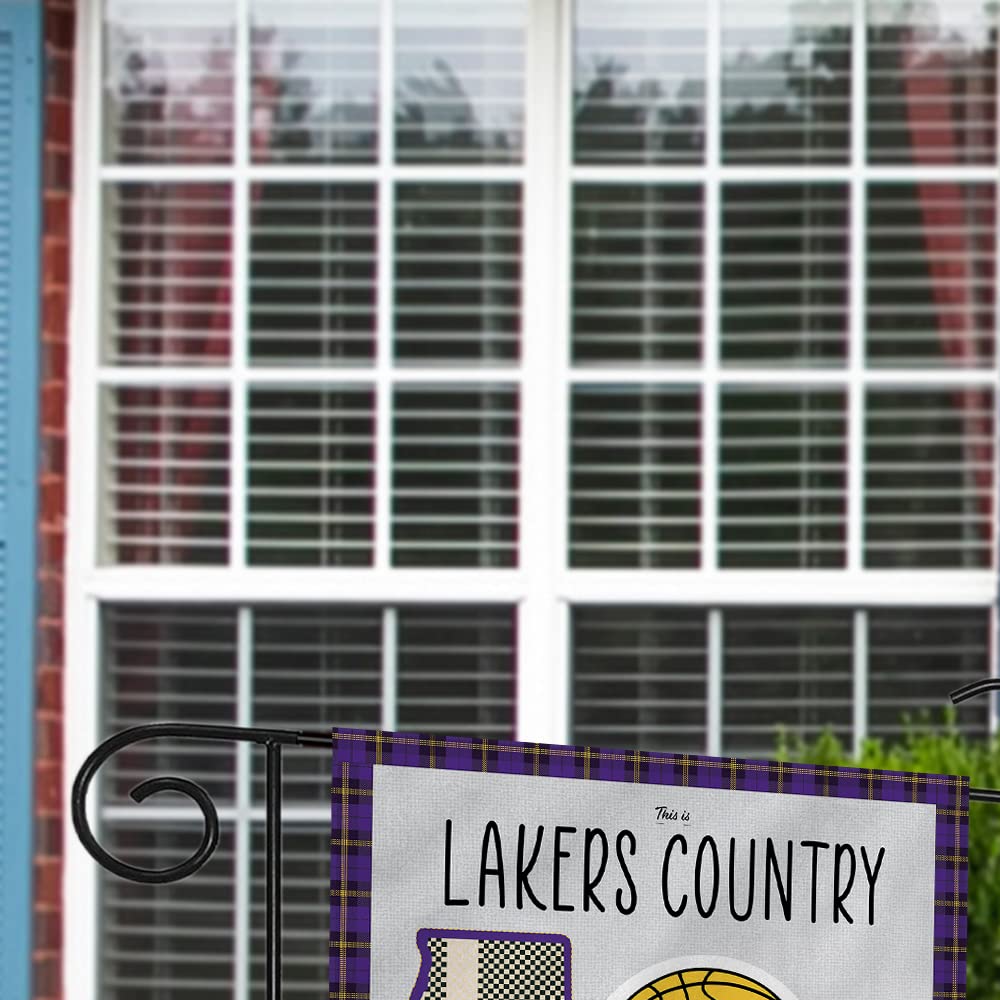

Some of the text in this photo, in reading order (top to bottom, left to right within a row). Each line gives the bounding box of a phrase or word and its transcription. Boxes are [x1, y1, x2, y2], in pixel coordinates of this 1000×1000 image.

[655, 806, 691, 822] This is
[444, 819, 886, 926] LAKERS COUNTRY
